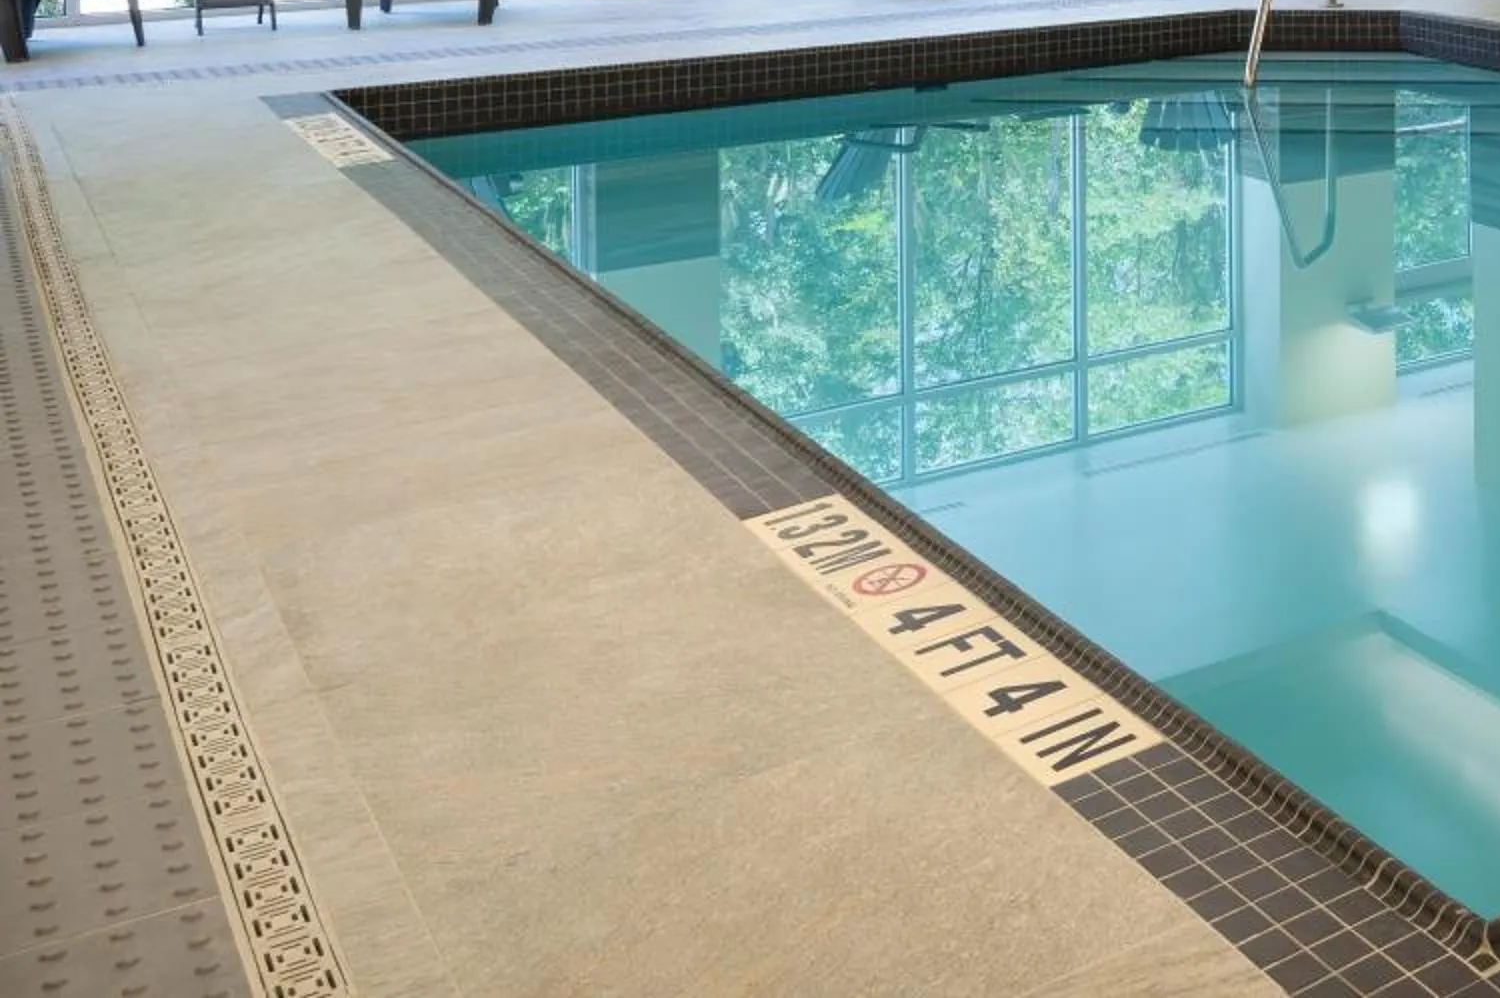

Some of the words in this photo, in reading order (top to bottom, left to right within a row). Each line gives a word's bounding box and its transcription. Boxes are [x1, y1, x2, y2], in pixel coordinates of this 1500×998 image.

[888, 603, 967, 635] 4
[915, 625, 1027, 678] FT
[982, 680, 1068, 718] 4
[1020, 707, 1136, 772] IN
